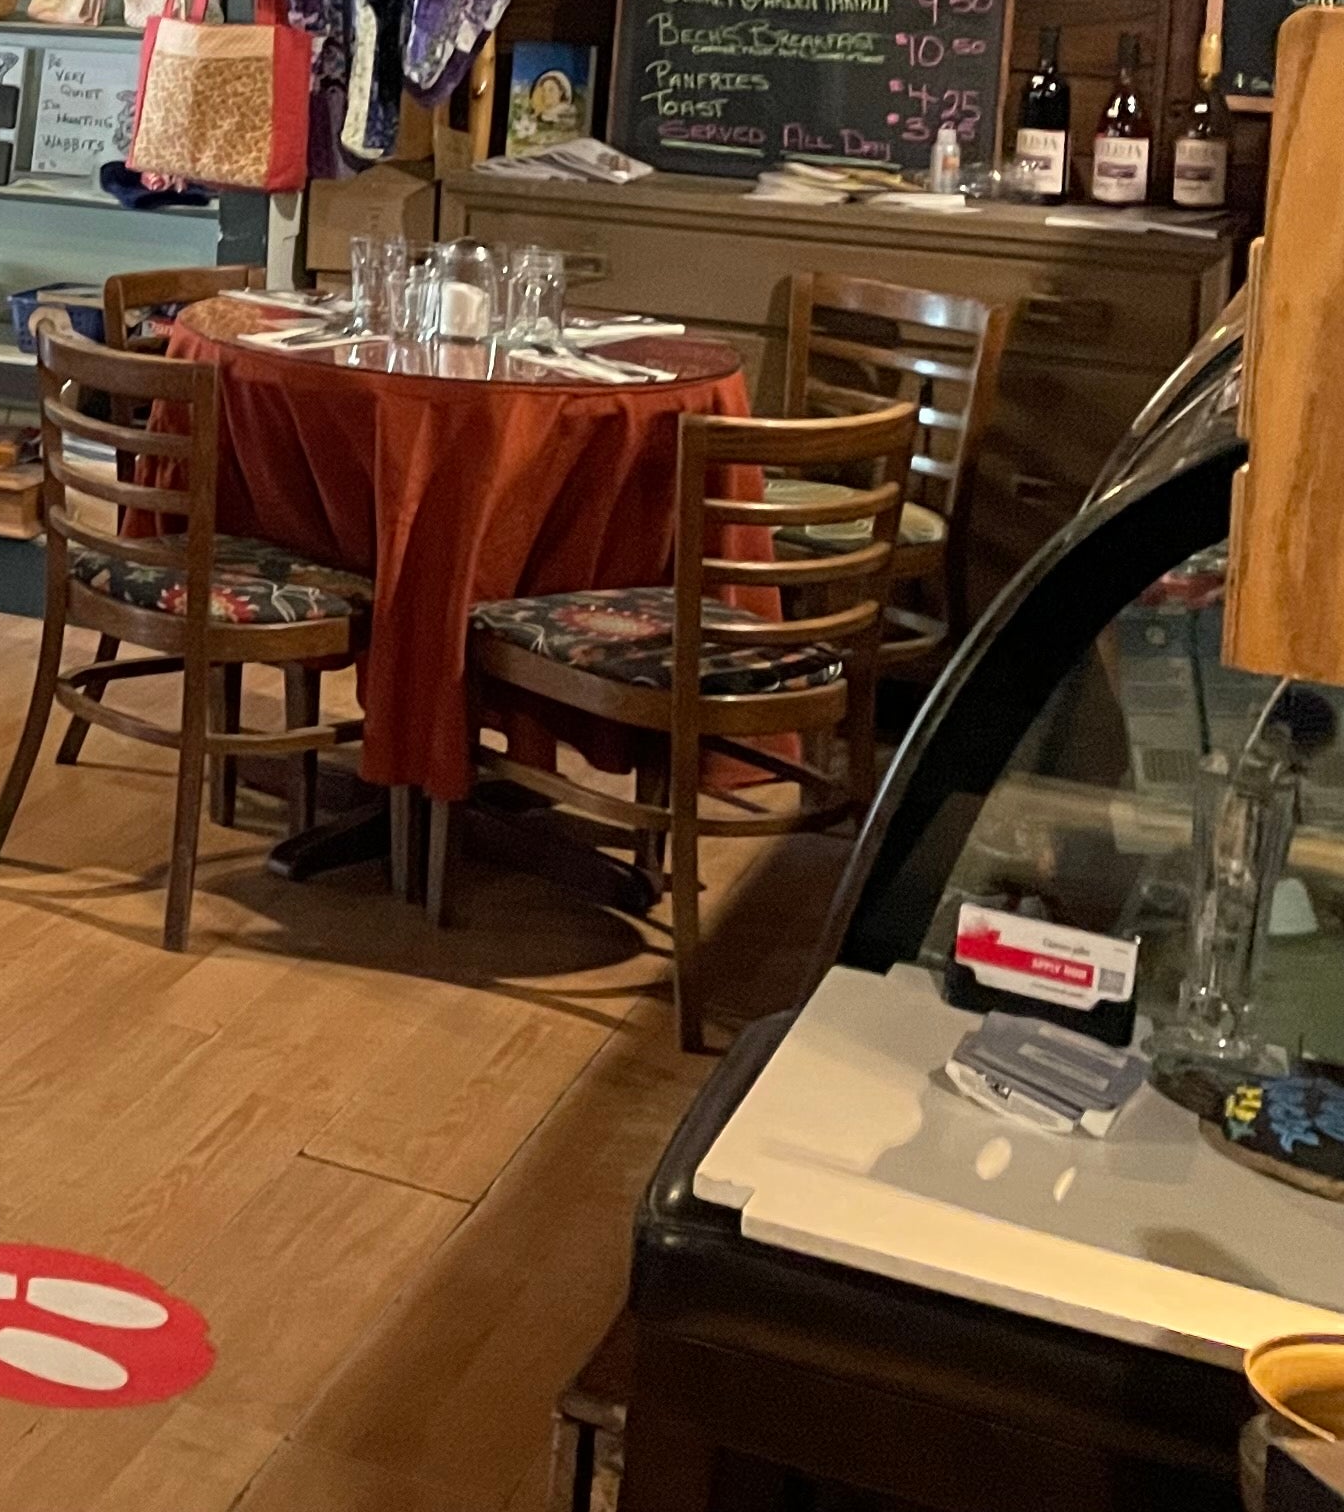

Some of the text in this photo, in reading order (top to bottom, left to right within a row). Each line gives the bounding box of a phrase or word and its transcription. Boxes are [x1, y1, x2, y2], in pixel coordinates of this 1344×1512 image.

[734, 18, 876, 51] BREAKFAST
[55, 69, 86, 84] VERY
[645, 59, 770, 90] PANFRIES
[60, 84, 104, 100] QUIET
[640, 89, 730, 118] TOAST
[56, 113, 113, 129] HUNTING
[42, 133, 105, 154] WABBITS
[657, 119, 892, 161] SERVED ALL DAY
